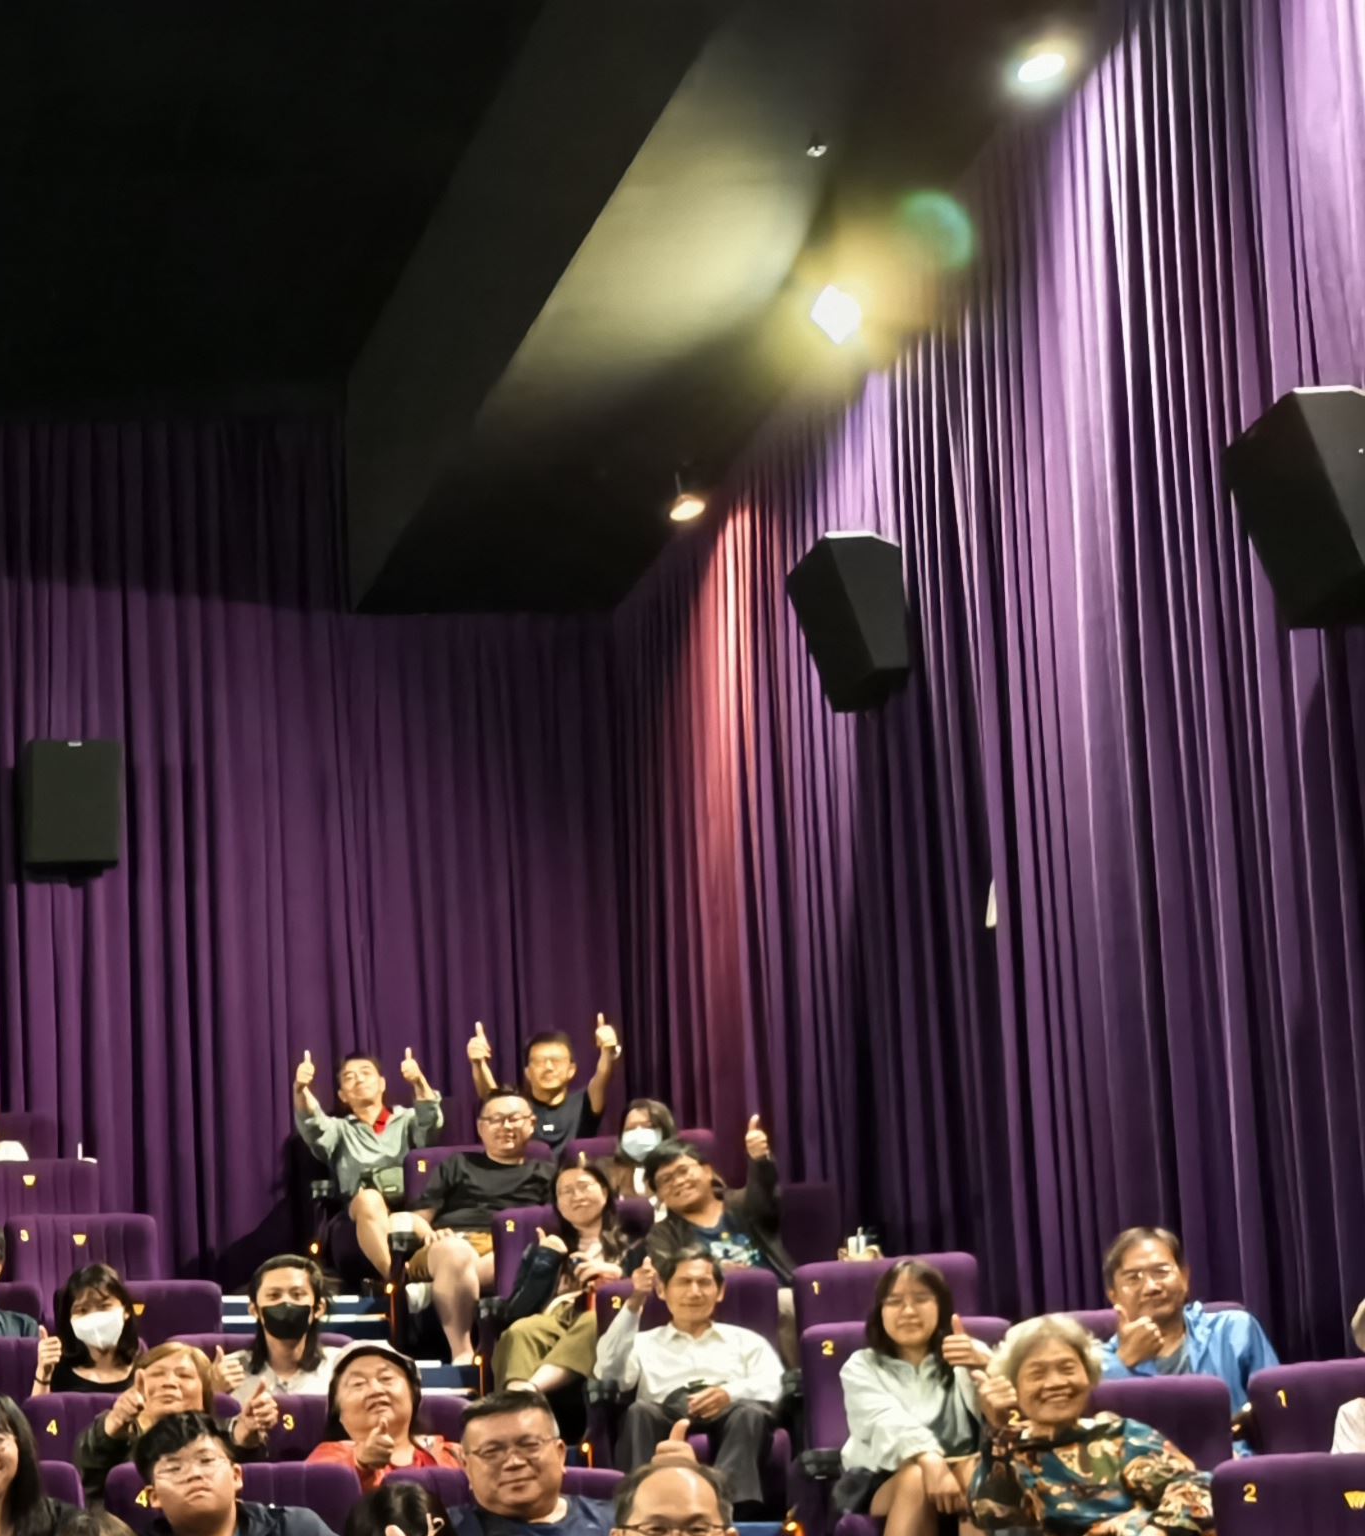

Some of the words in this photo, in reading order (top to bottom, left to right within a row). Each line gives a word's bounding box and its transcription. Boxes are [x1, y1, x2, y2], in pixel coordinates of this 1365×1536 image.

[812, 1281, 820, 1295] 1
[822, 1340, 834, 1356] 2
[1277, 1390, 1287, 1407] 1
[46, 1419, 58, 1436] 4
[283, 1414, 295, 1430] 3
[1244, 1483, 1257, 1503] 2
[135, 1491, 149, 1513] 4
